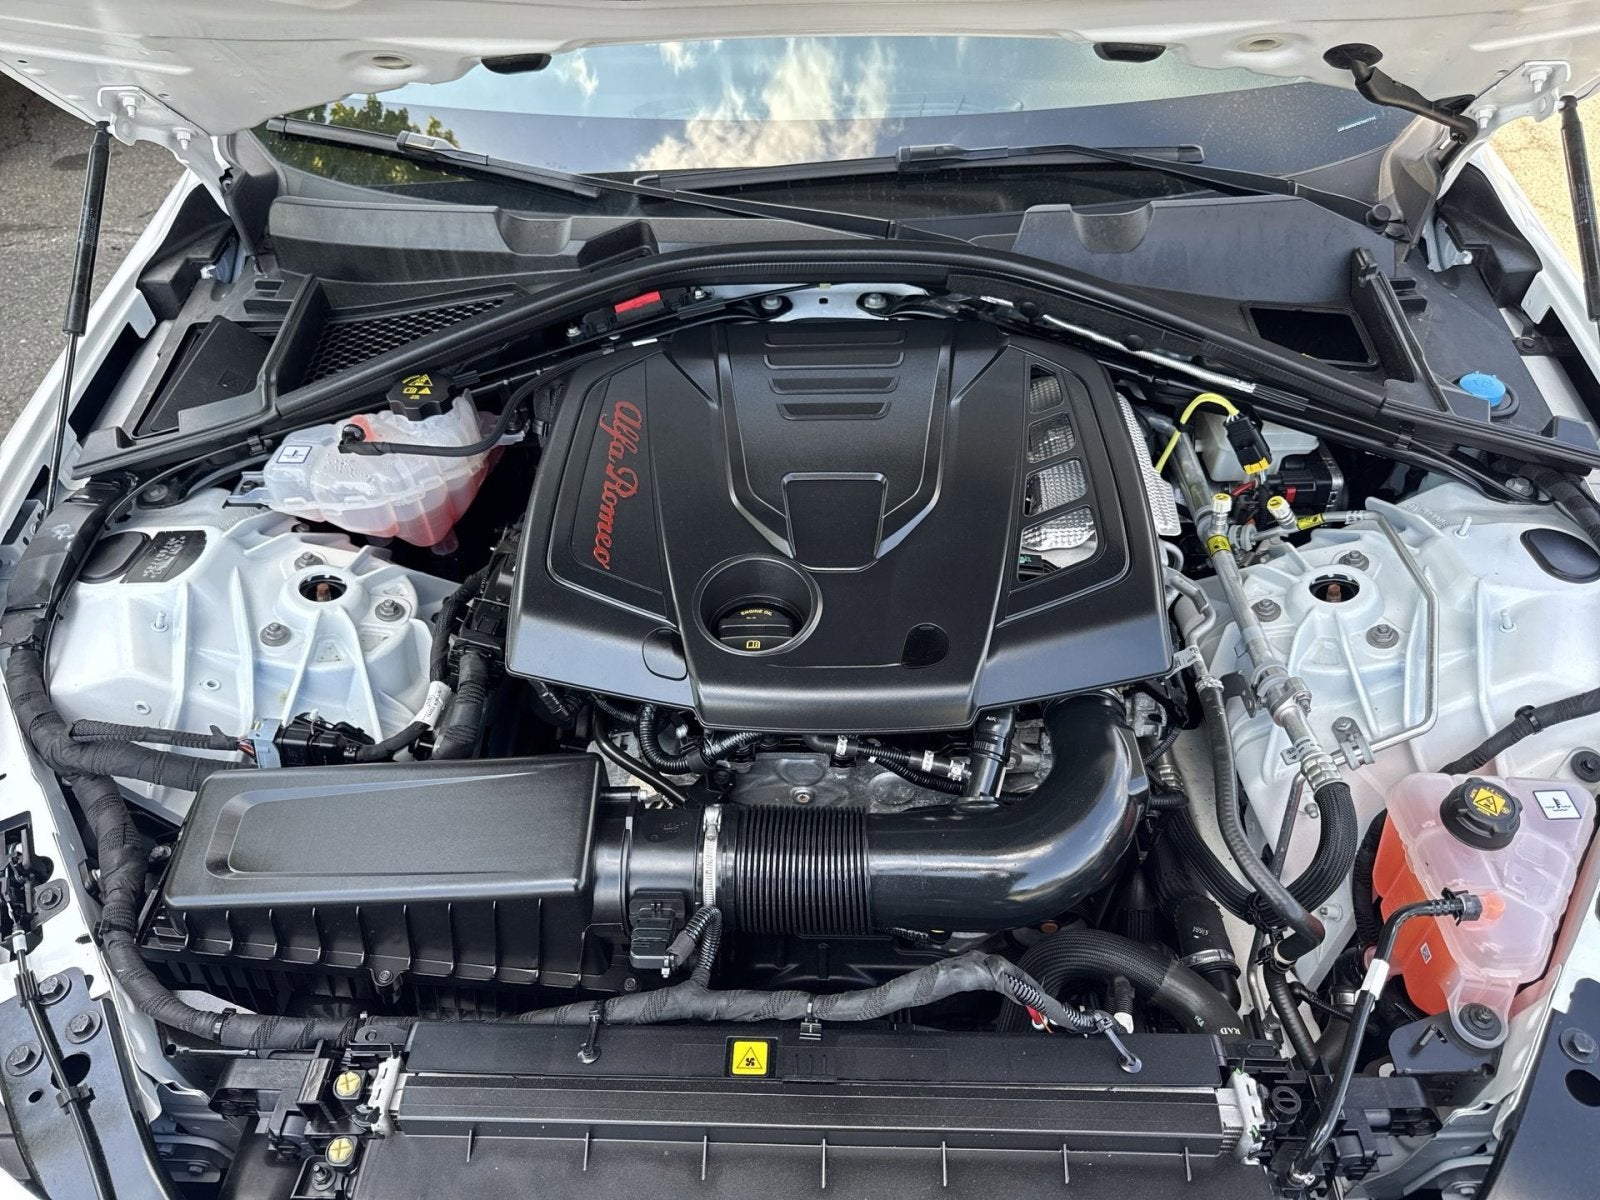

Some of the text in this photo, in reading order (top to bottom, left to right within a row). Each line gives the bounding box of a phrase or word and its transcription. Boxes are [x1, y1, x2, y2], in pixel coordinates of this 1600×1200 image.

[593, 400, 642, 570] Alfa Romeo
[1220, 1027, 1242, 1035] RAD
